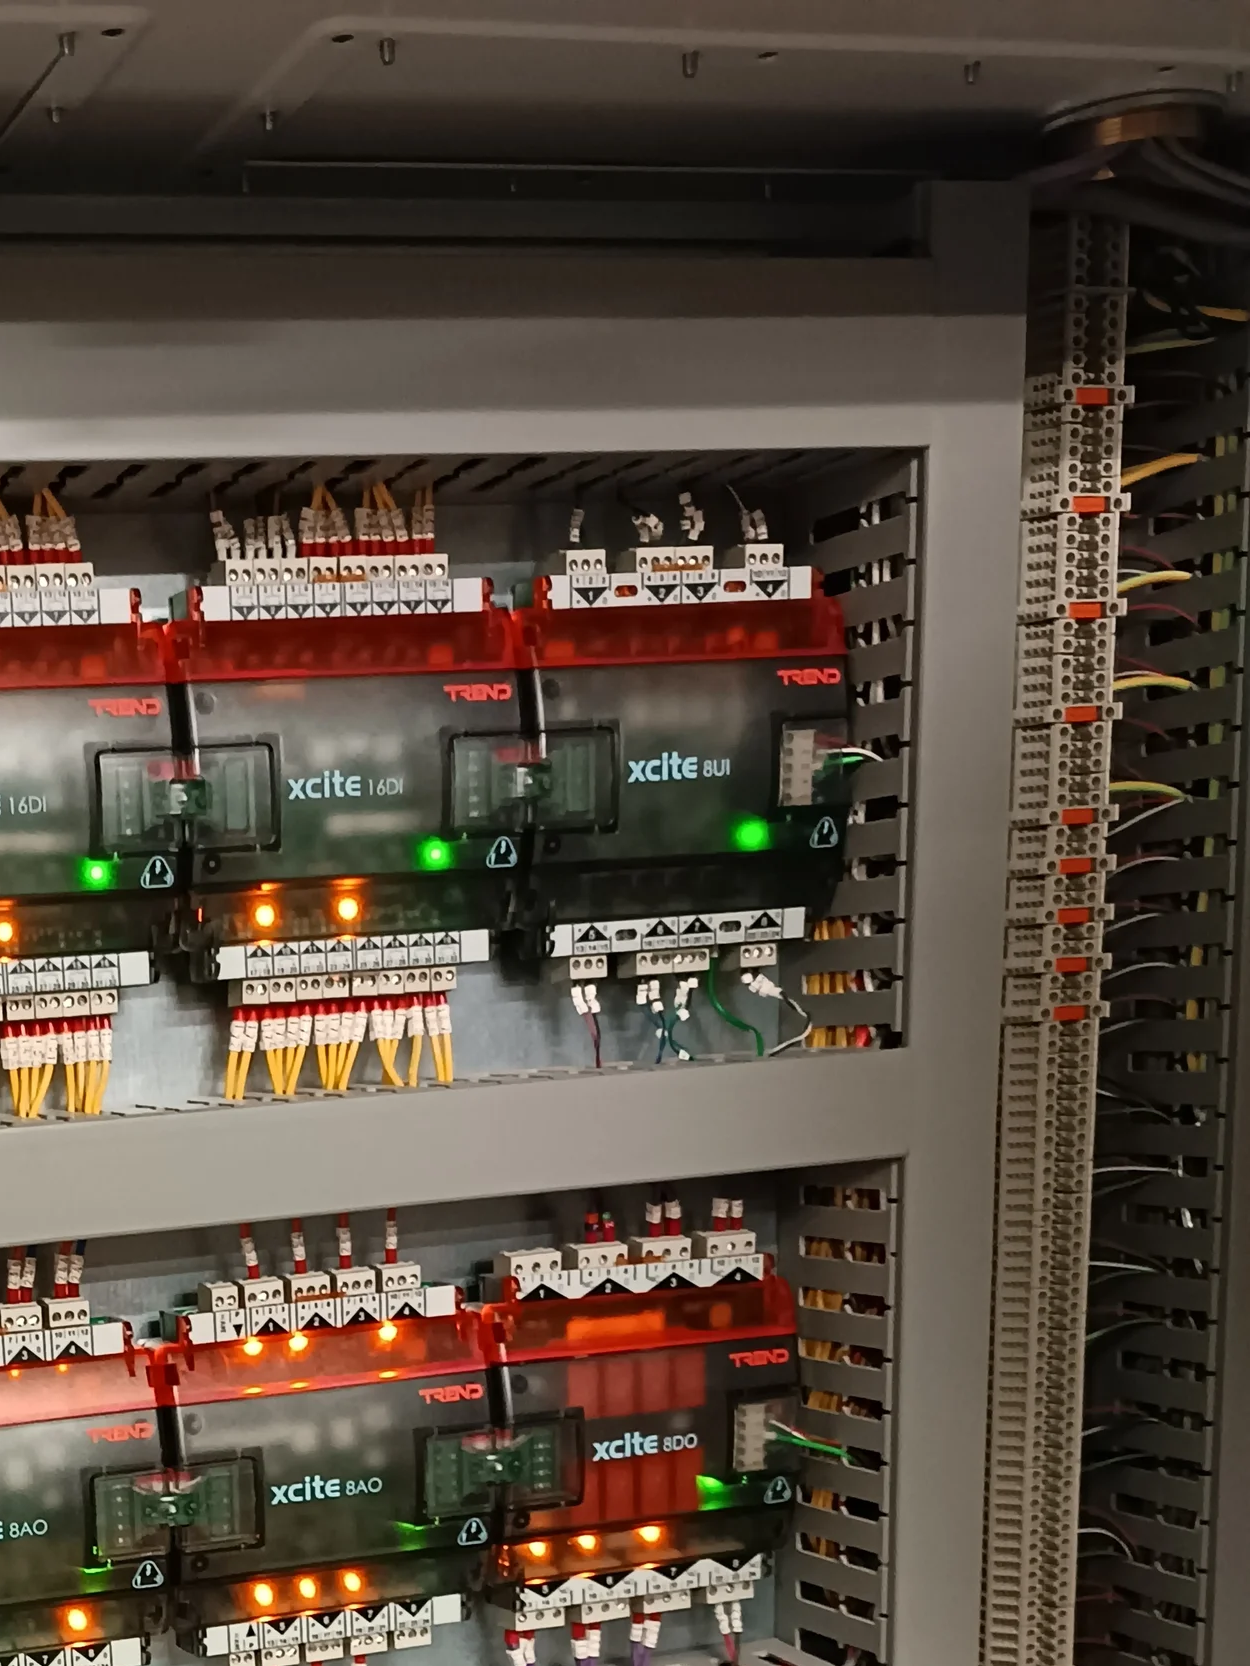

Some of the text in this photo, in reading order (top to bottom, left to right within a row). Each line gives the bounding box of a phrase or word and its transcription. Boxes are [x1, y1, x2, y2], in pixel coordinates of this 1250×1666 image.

[777, 668, 841, 686] TREND
[443, 683, 512, 702] TREND
[88, 698, 161, 717] TREND
[628, 751, 730, 783] xcite 8UI
[288, 770, 403, 800] xcite 16DI
[9, 796, 46, 815] 16DI
[729, 1349, 789, 1368] TREND
[419, 1384, 483, 1404] TREND
[592, 1431, 698, 1461] xcite 8DO
[271, 1475, 382, 1505] xcite 8AO
[9, 1519, 48, 1538] 8AO
